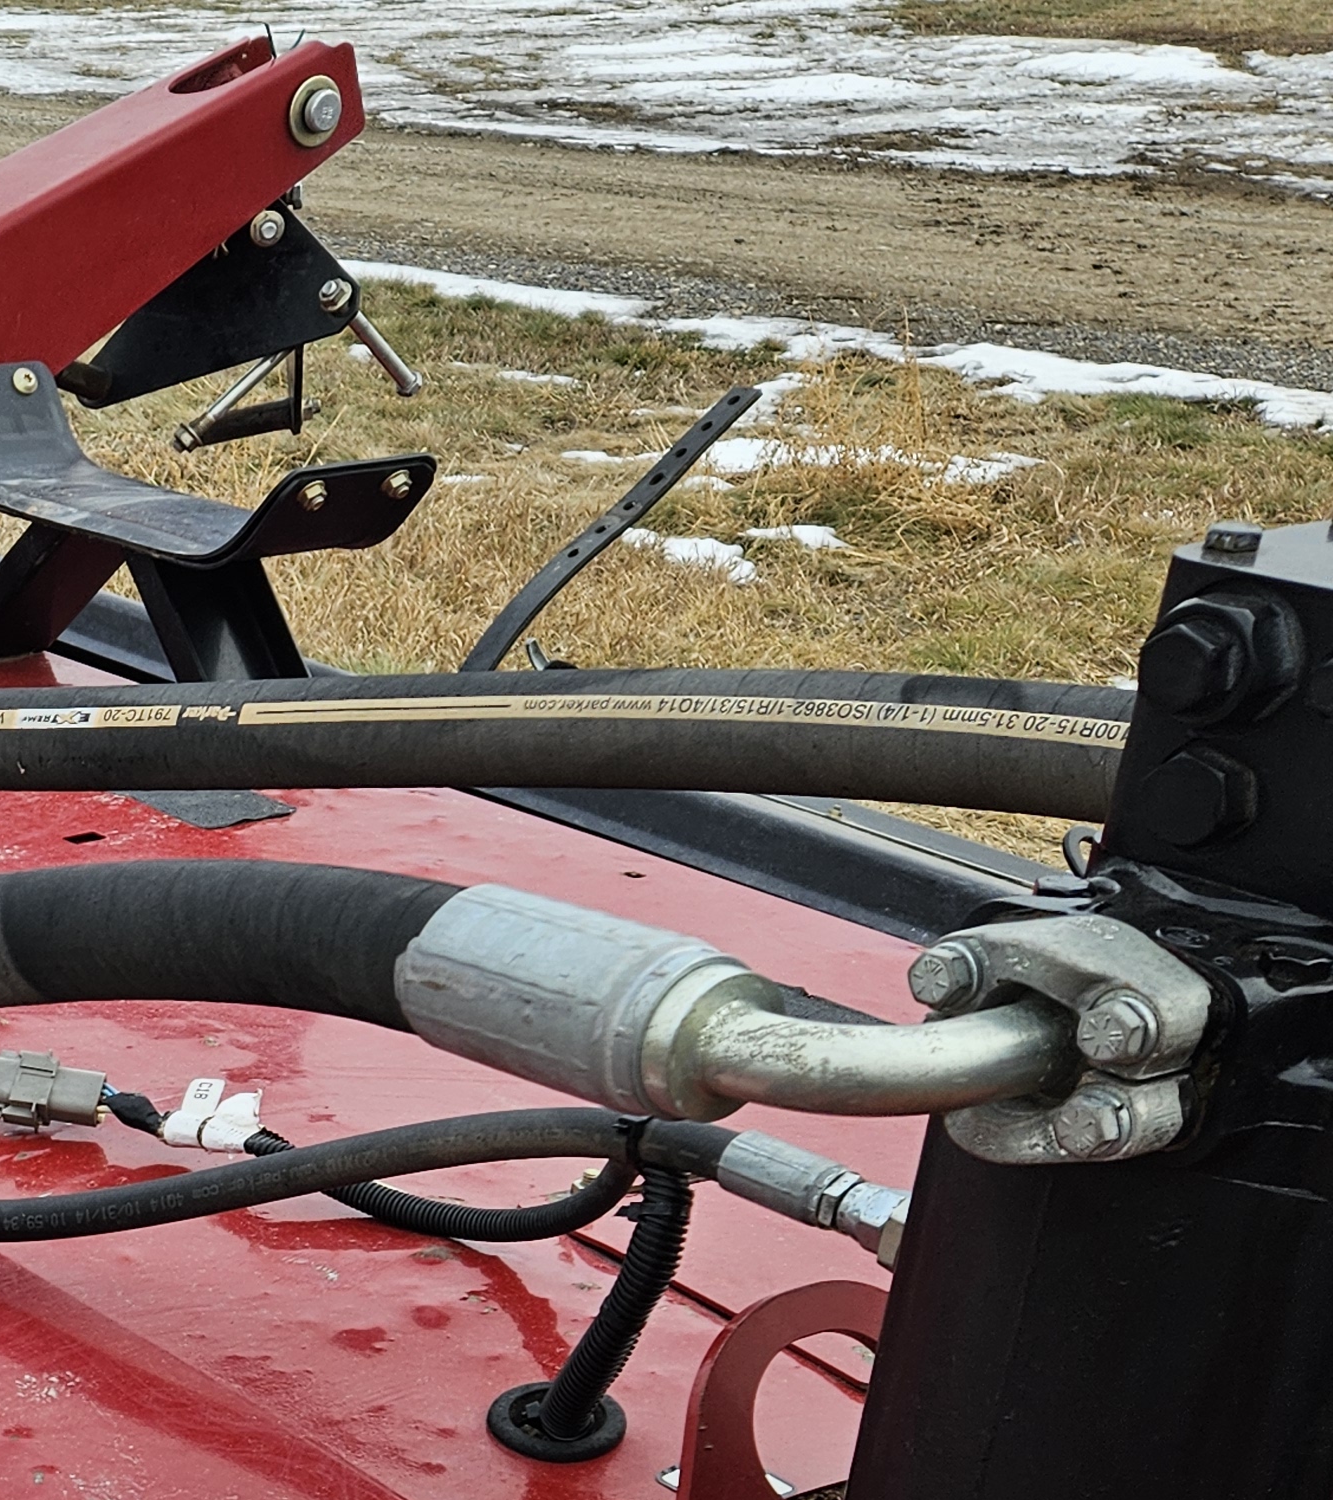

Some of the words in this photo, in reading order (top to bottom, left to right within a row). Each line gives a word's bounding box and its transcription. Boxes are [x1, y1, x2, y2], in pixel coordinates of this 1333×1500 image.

[182, 705, 237, 721] Parker
[524, 697, 652, 713] www.parker.com
[876, 703, 937, 726] (1-1/4)
[103, 707, 172, 723] 791TC-20
[942, 707, 1020, 730] 31.5mm
[74, 1200, 141, 1224] 10/31/14
